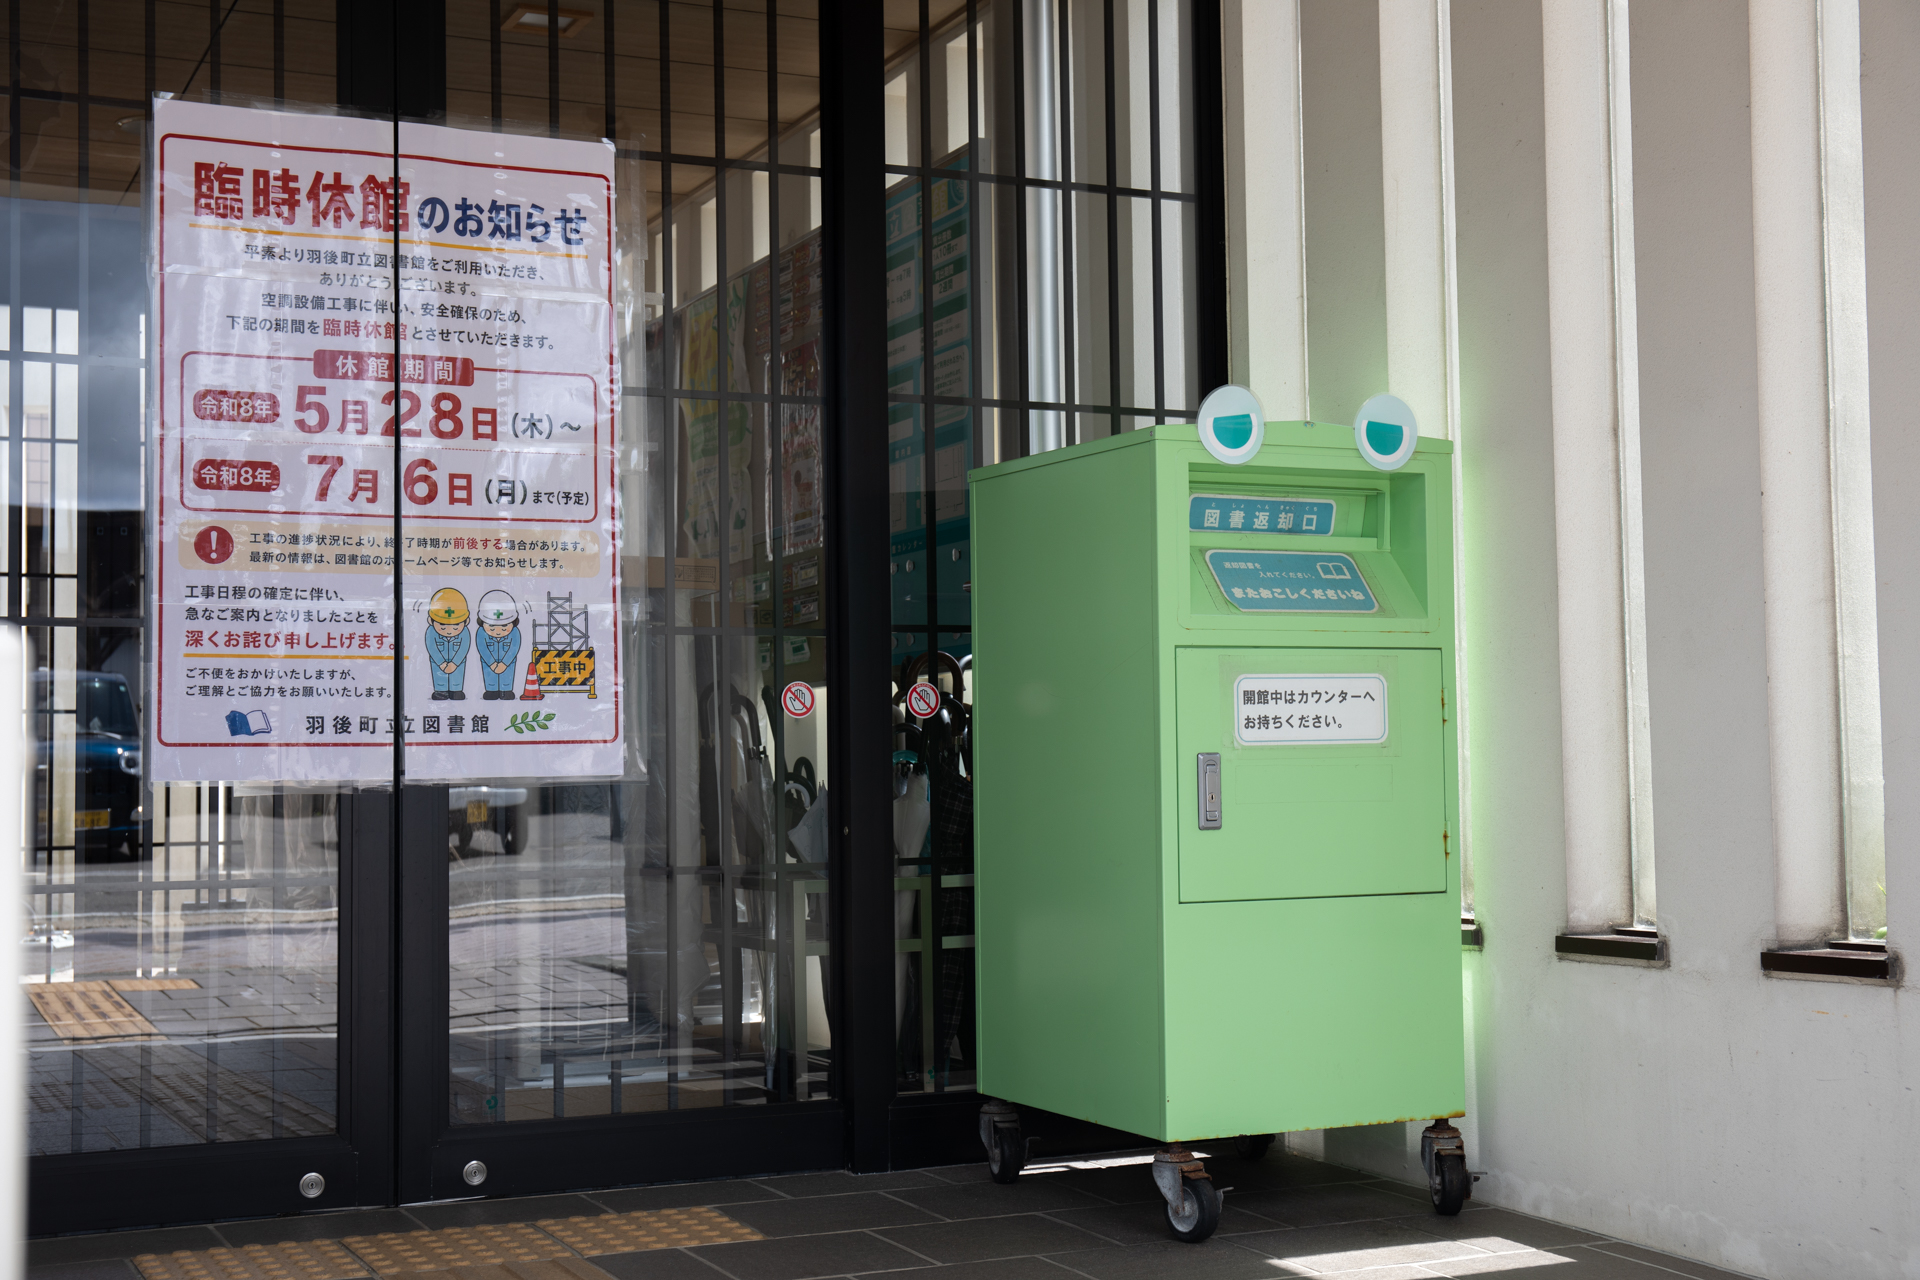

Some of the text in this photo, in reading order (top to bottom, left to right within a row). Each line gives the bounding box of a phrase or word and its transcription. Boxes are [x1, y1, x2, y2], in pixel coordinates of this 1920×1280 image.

[194, 161, 587, 246] 臨時休館のお知らせ
[244, 243, 545, 281] 平素より羽後町立図書館をご利用いただき、
[320, 271, 478, 297] ありがとうございます。
[261, 291, 528, 325] 空調設備工事に伴い、安全確保のため、
[226, 313, 555, 350] 下記の期間を臨時休館とさせていただきます。
[336, 355, 453, 382] 休館期間
[200, 396, 272, 418] 令和8年
[200, 466, 272, 487] 令和8年
[1203, 508, 1318, 531] 図書返却口
[249, 531, 586, 553] 工事の進捗状況により、終了時期が前後する場合があります。
[249, 551, 566, 570] 最新の情報は、図書館のホームページ等でお知らせします。
[1223, 561, 1262, 570] 返却図書を
[1259, 571, 1316, 579] 入れてください。
[185, 584, 345, 602] 工事日程の確定に伴い、
[1231, 586, 1366, 601] またおこしくださいね
[185, 606, 378, 624] 急なご案内となりましたことを
[185, 629, 397, 650] 深くお詫び申し上げます。
[185, 667, 357, 681] ご不便をおかけいたしますが、
[543, 660, 586, 675] 工事中
[185, 684, 393, 698] ご理解とご協力をお願いいたします。
[1243, 689, 1376, 706] 開館中はカウンターへ
[305, 714, 490, 735] 羽後町立図書館
[1243, 714, 1343, 730] お持ちください。
